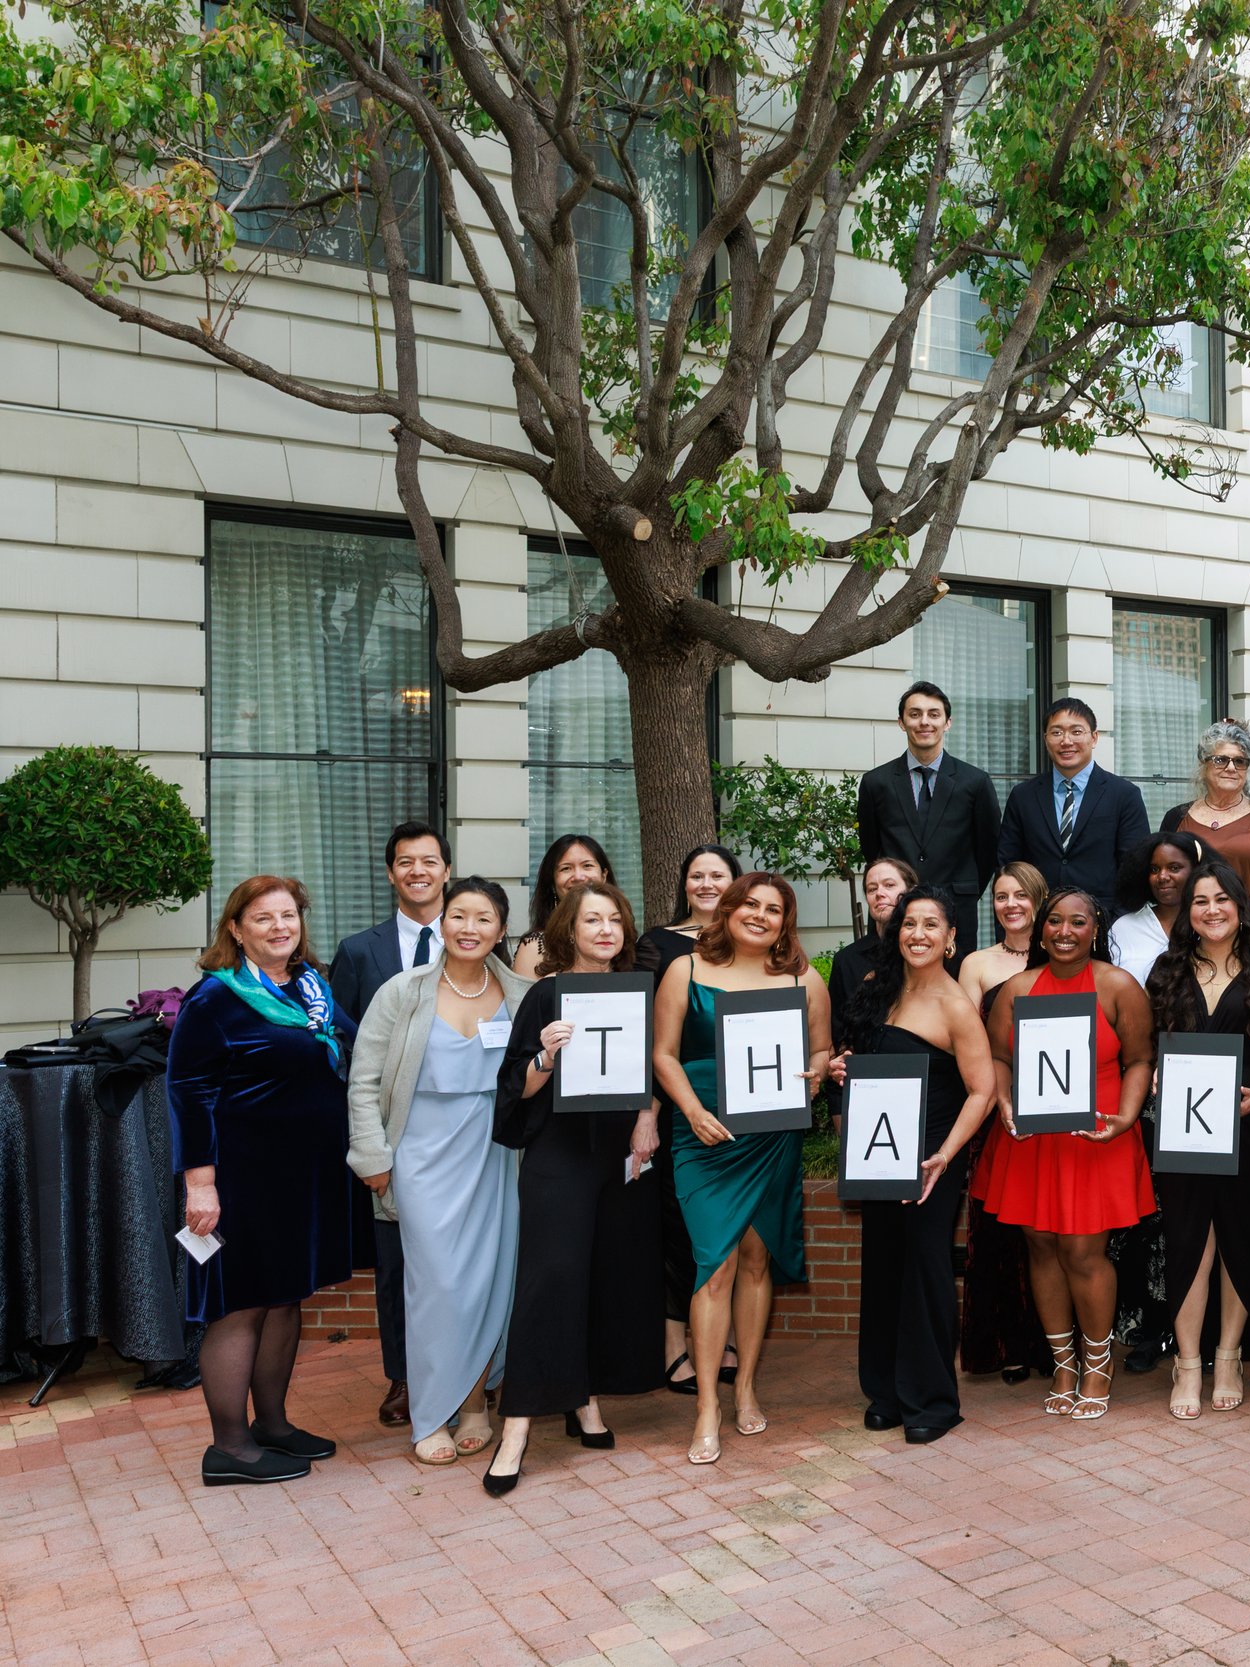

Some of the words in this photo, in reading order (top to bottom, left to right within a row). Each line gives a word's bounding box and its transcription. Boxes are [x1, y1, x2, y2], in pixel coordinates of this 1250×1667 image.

[585, 1026, 623, 1076] T
[748, 1044, 783, 1094] H
[1038, 1049, 1070, 1097] N
[1185, 1087, 1214, 1135] K
[864, 1112, 900, 1161] A
